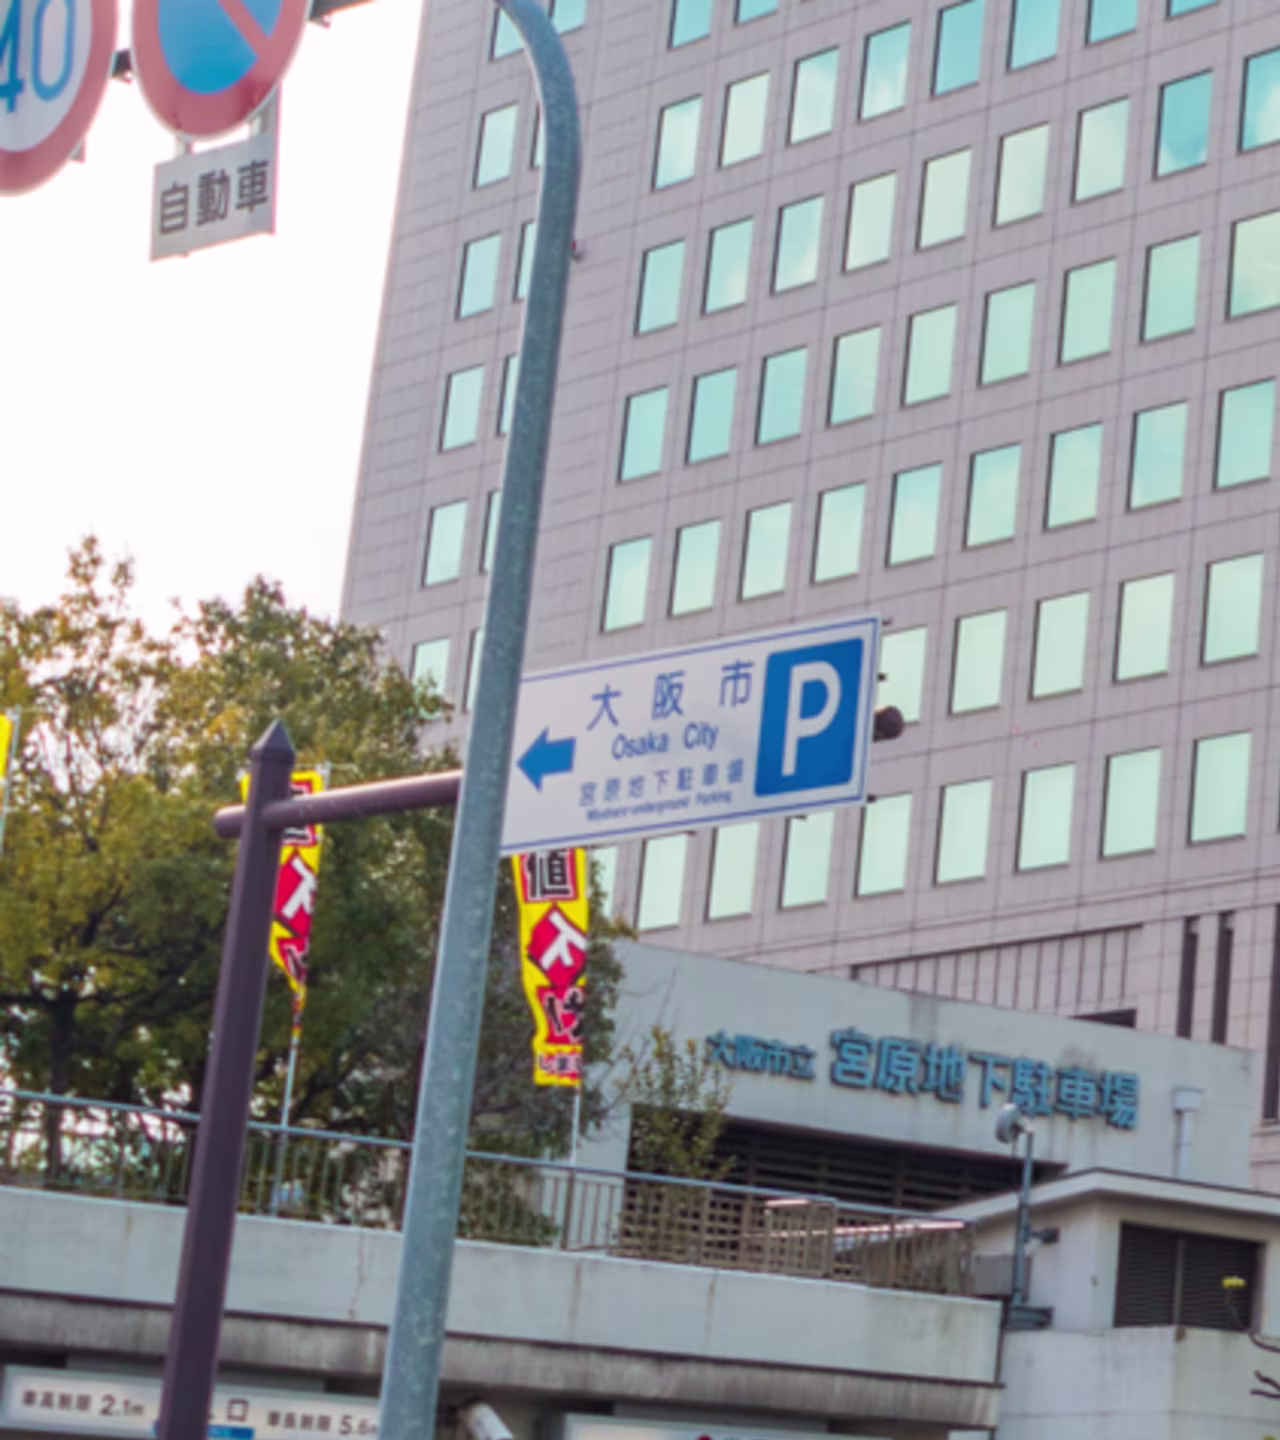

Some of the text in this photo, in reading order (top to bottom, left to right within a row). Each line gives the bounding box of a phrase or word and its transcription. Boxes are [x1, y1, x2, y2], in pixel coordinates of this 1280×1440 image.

[158, 160, 270, 235] 自動車
[586, 659, 755, 731] 大阪市
[782, 661, 842, 777] P
[612, 722, 719, 760] Osaka City
[705, 1027, 1141, 1130] 大阪市立 宮原地下駐車場
